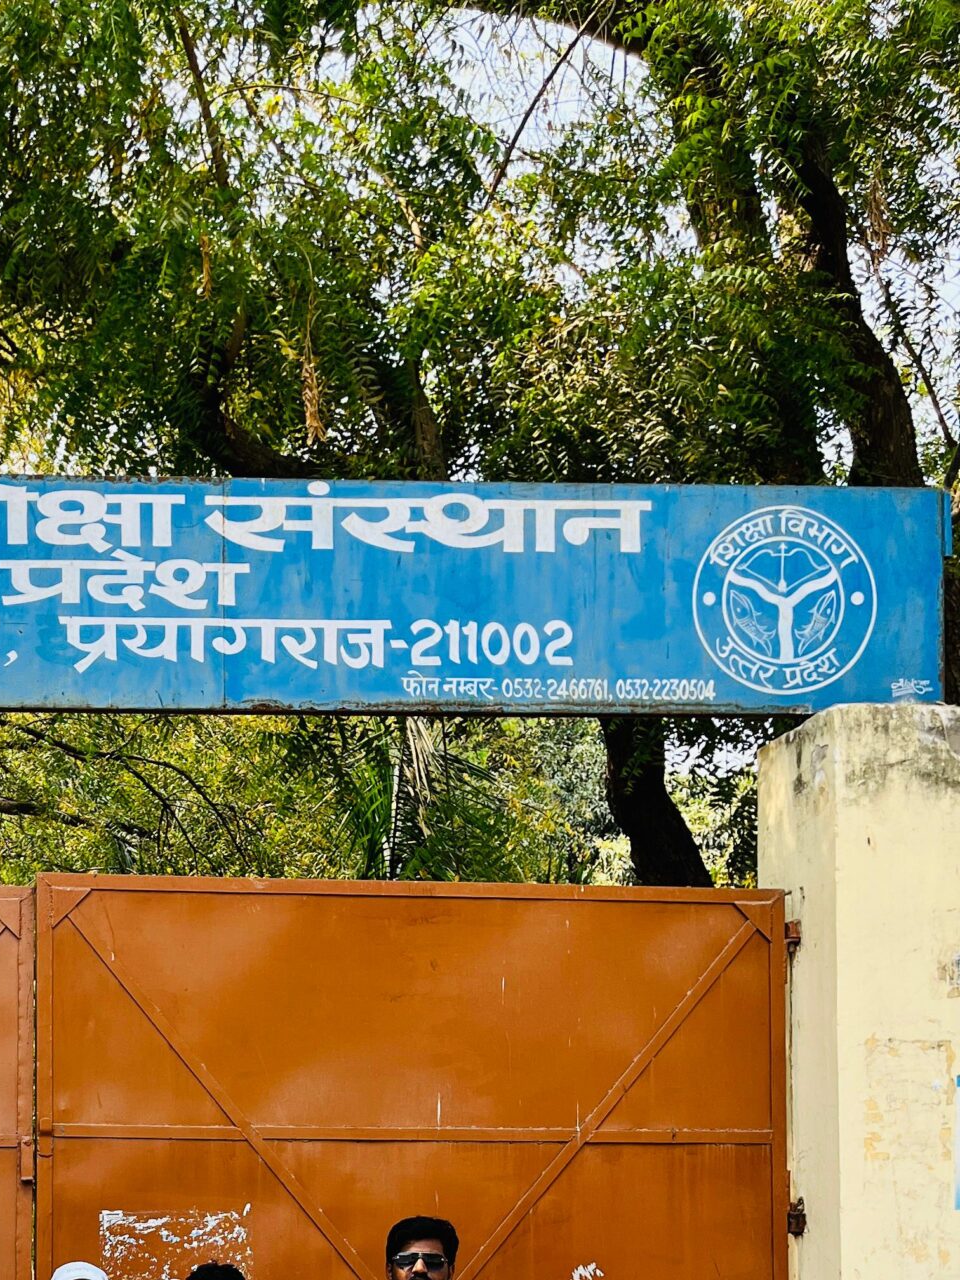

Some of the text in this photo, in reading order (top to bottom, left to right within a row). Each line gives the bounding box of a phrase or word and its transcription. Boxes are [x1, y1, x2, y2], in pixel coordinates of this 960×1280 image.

[204, 480, 652, 553] संस्थान
[710, 509, 859, 568] शिक्षा विभाग
[58, 615, 574, 674] प्रयागराज-211002
[716, 636, 840, 689] उत्तर प्रदेश
[401, 669, 441, 697] फोन
[615, 678, 716, 702] 0532-2230504
